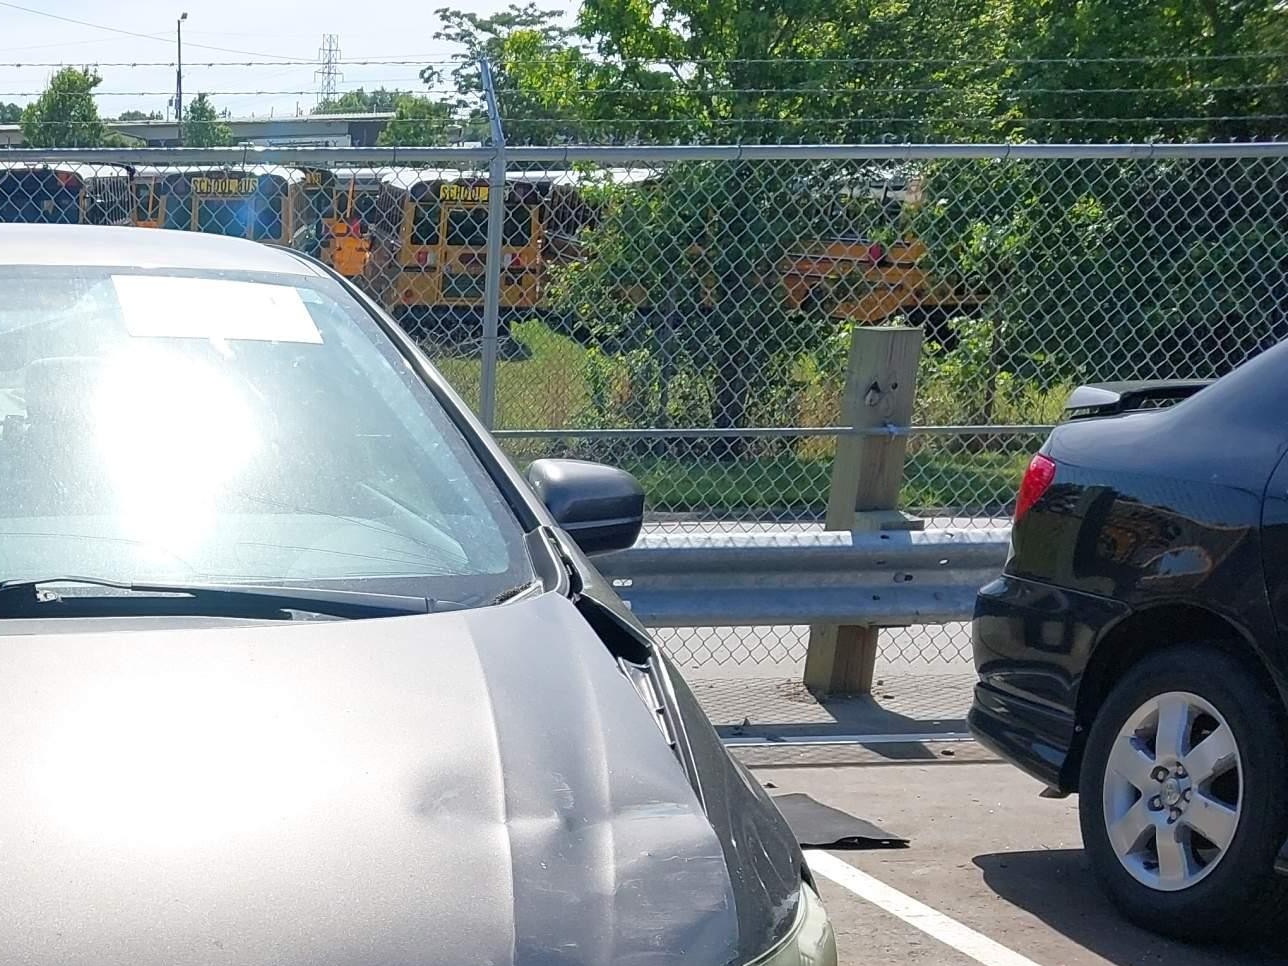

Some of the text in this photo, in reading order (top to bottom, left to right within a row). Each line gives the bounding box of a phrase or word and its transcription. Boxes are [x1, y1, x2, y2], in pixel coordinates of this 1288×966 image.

[192, 179, 257, 194] SCHOOL BUS
[441, 185, 485, 202] SCHOOL
